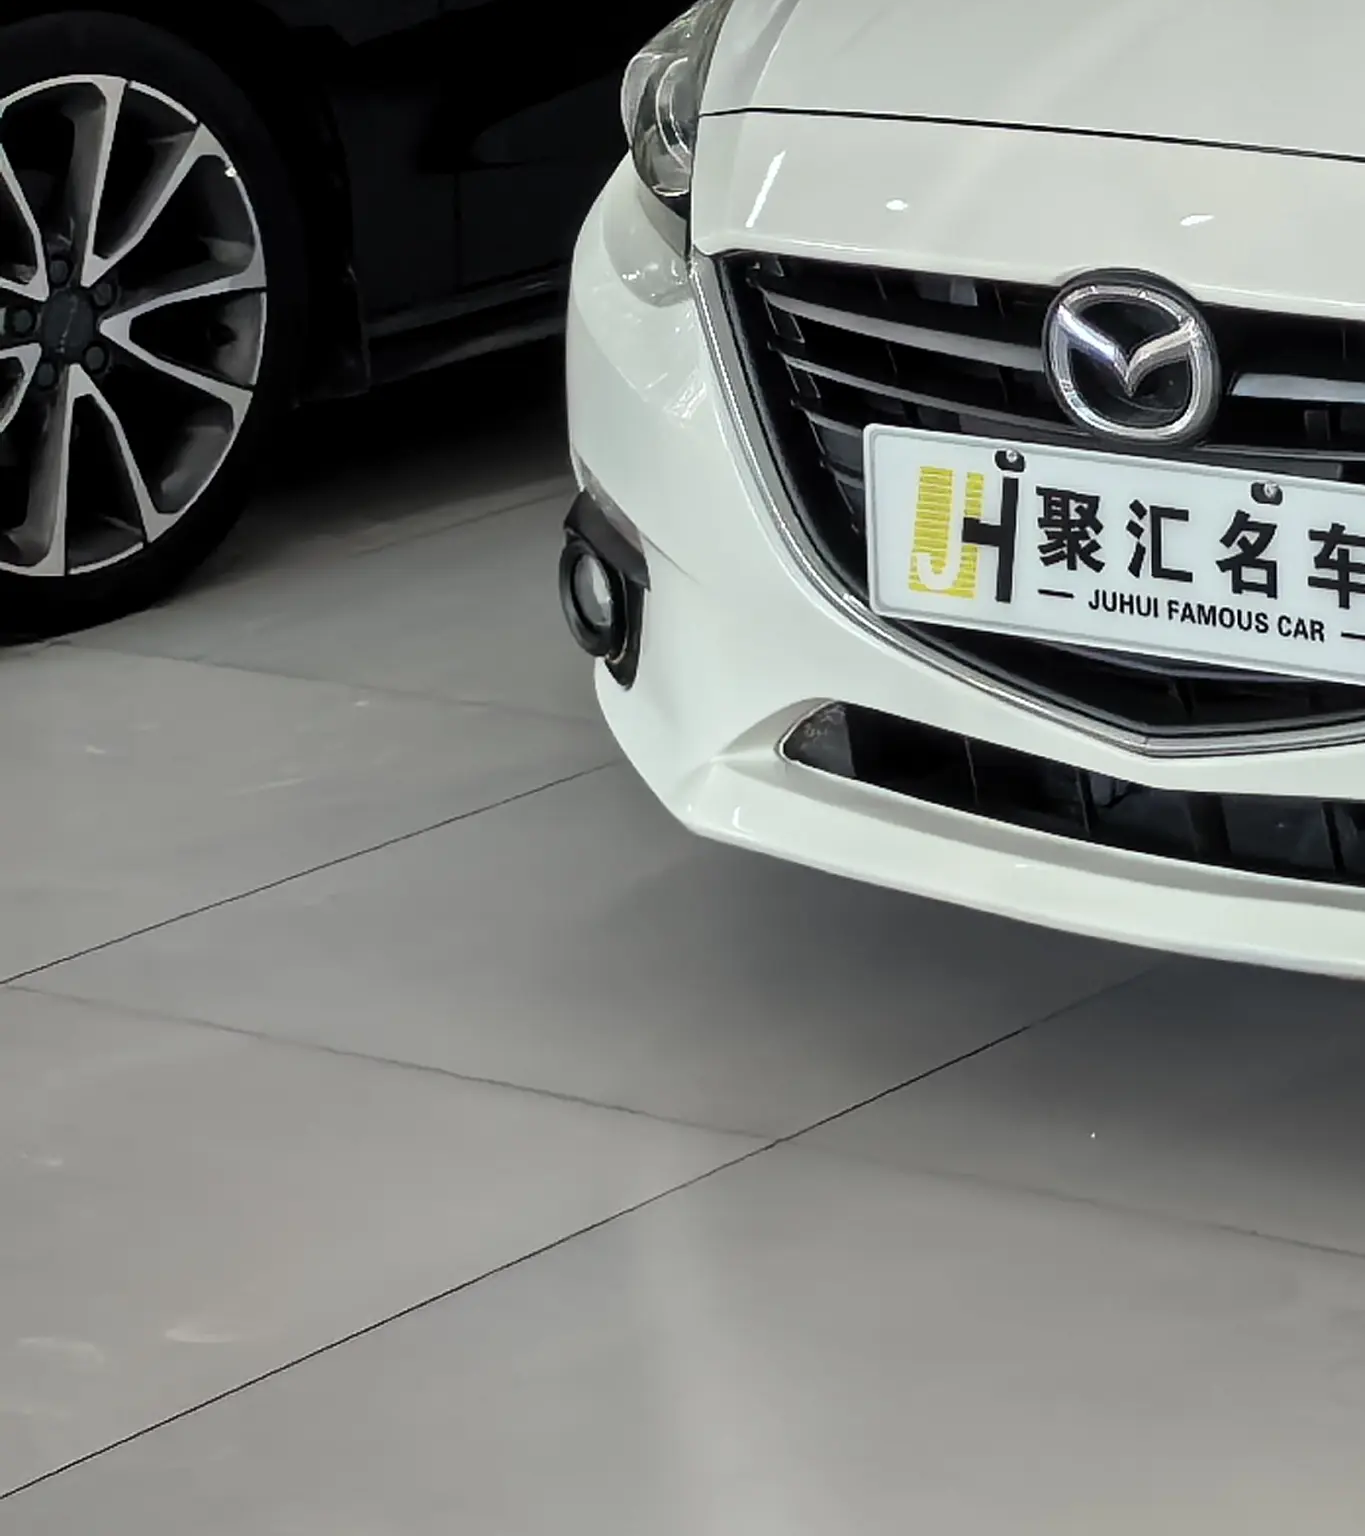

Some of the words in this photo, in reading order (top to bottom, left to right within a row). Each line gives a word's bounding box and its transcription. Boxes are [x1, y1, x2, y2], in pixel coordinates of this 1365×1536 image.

[1087, 588, 1160, 619] JUHUI
[1166, 599, 1270, 635] FAMOUS
[1276, 615, 1326, 643] CAR
